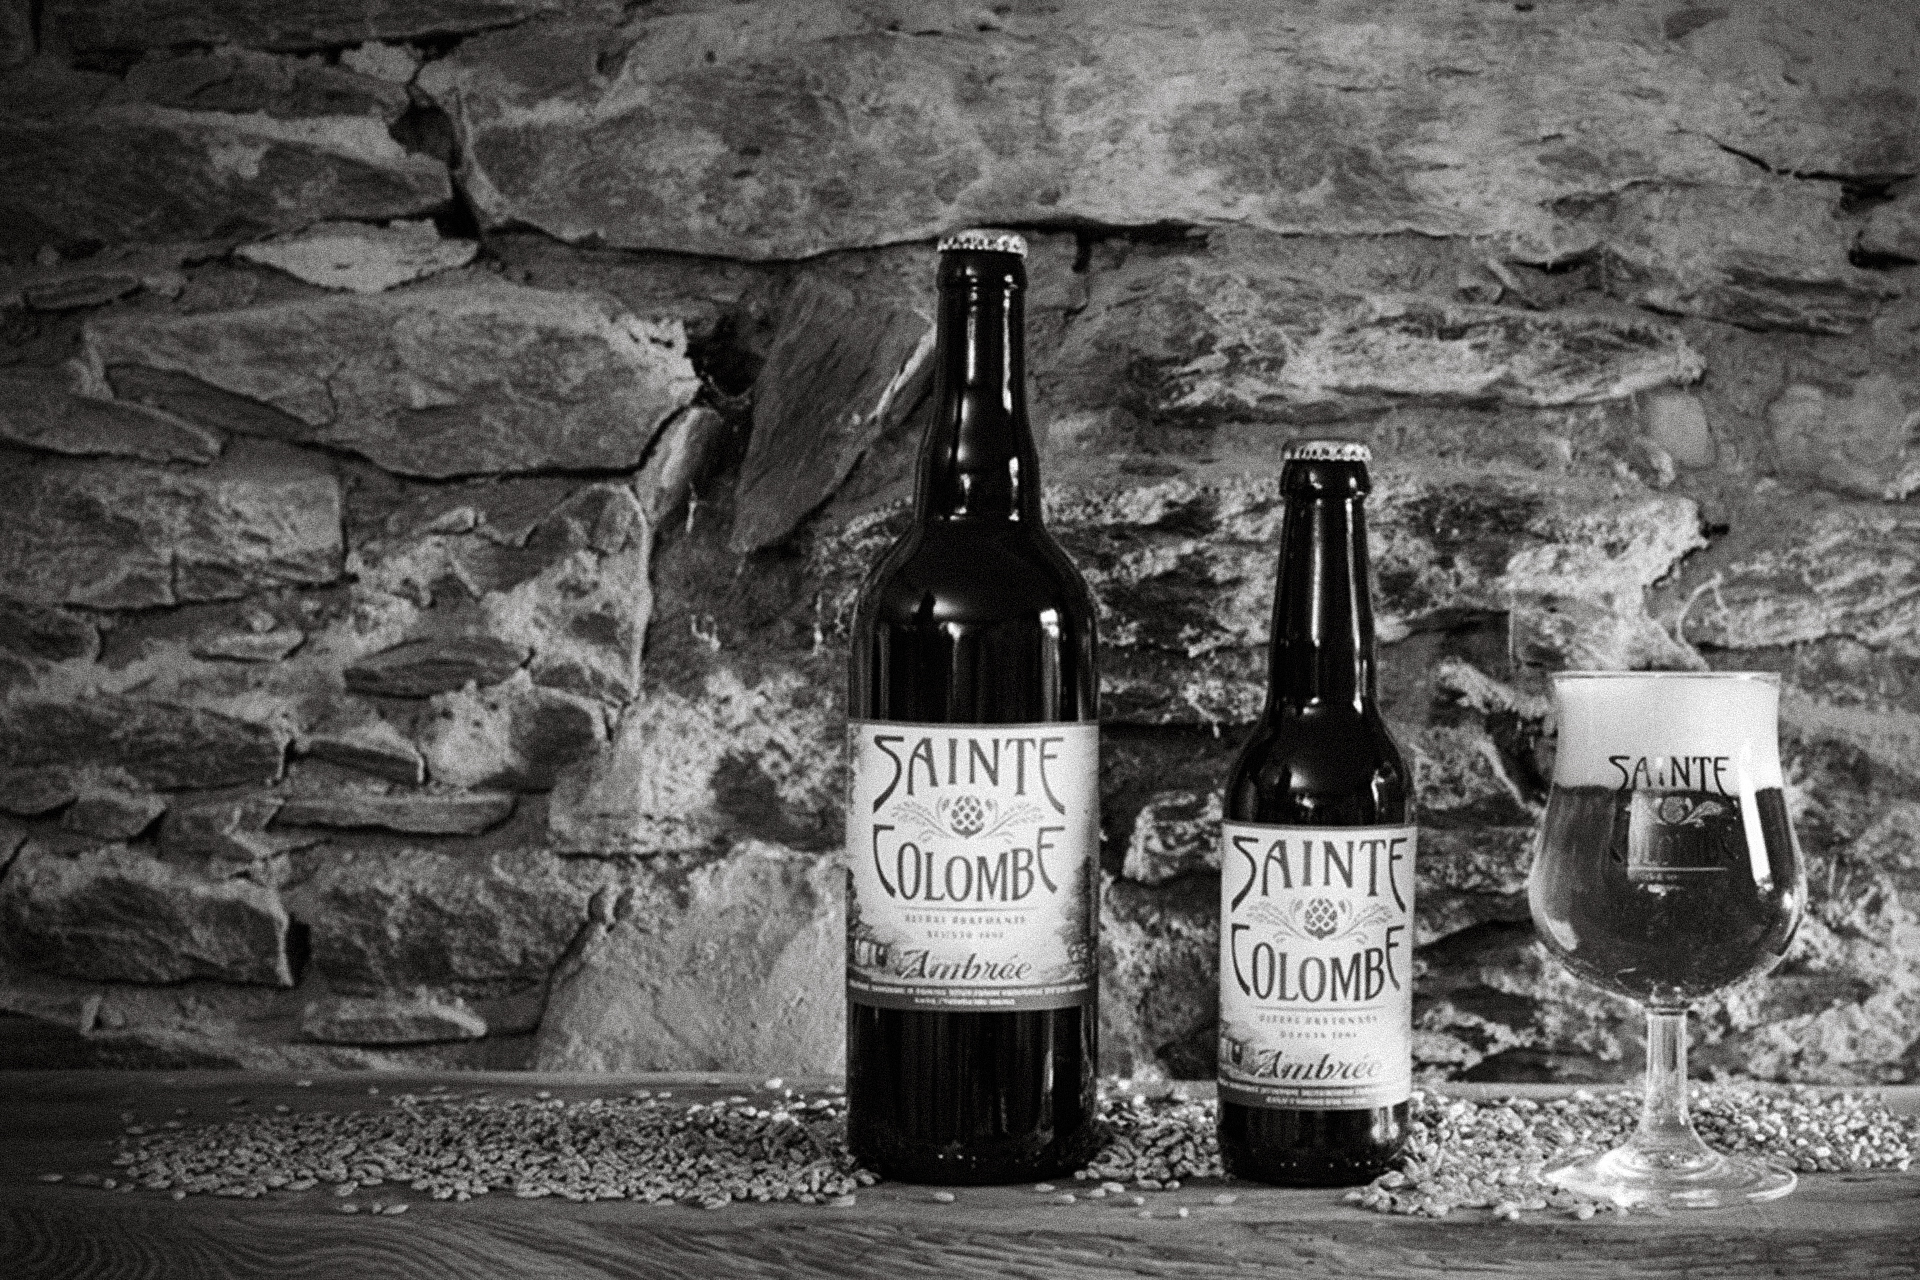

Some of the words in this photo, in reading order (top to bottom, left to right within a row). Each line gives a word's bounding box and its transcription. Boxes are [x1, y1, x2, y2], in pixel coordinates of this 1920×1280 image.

[873, 734, 1066, 815] SAINTE
[872, 824, 1066, 902] COLOMBE
[1231, 834, 1408, 913] SAINTE
[895, 949, 1032, 981] Ambrée
[1231, 922, 1405, 1003] COLOMBE
[1251, 1049, 1383, 1080] Ambrée
